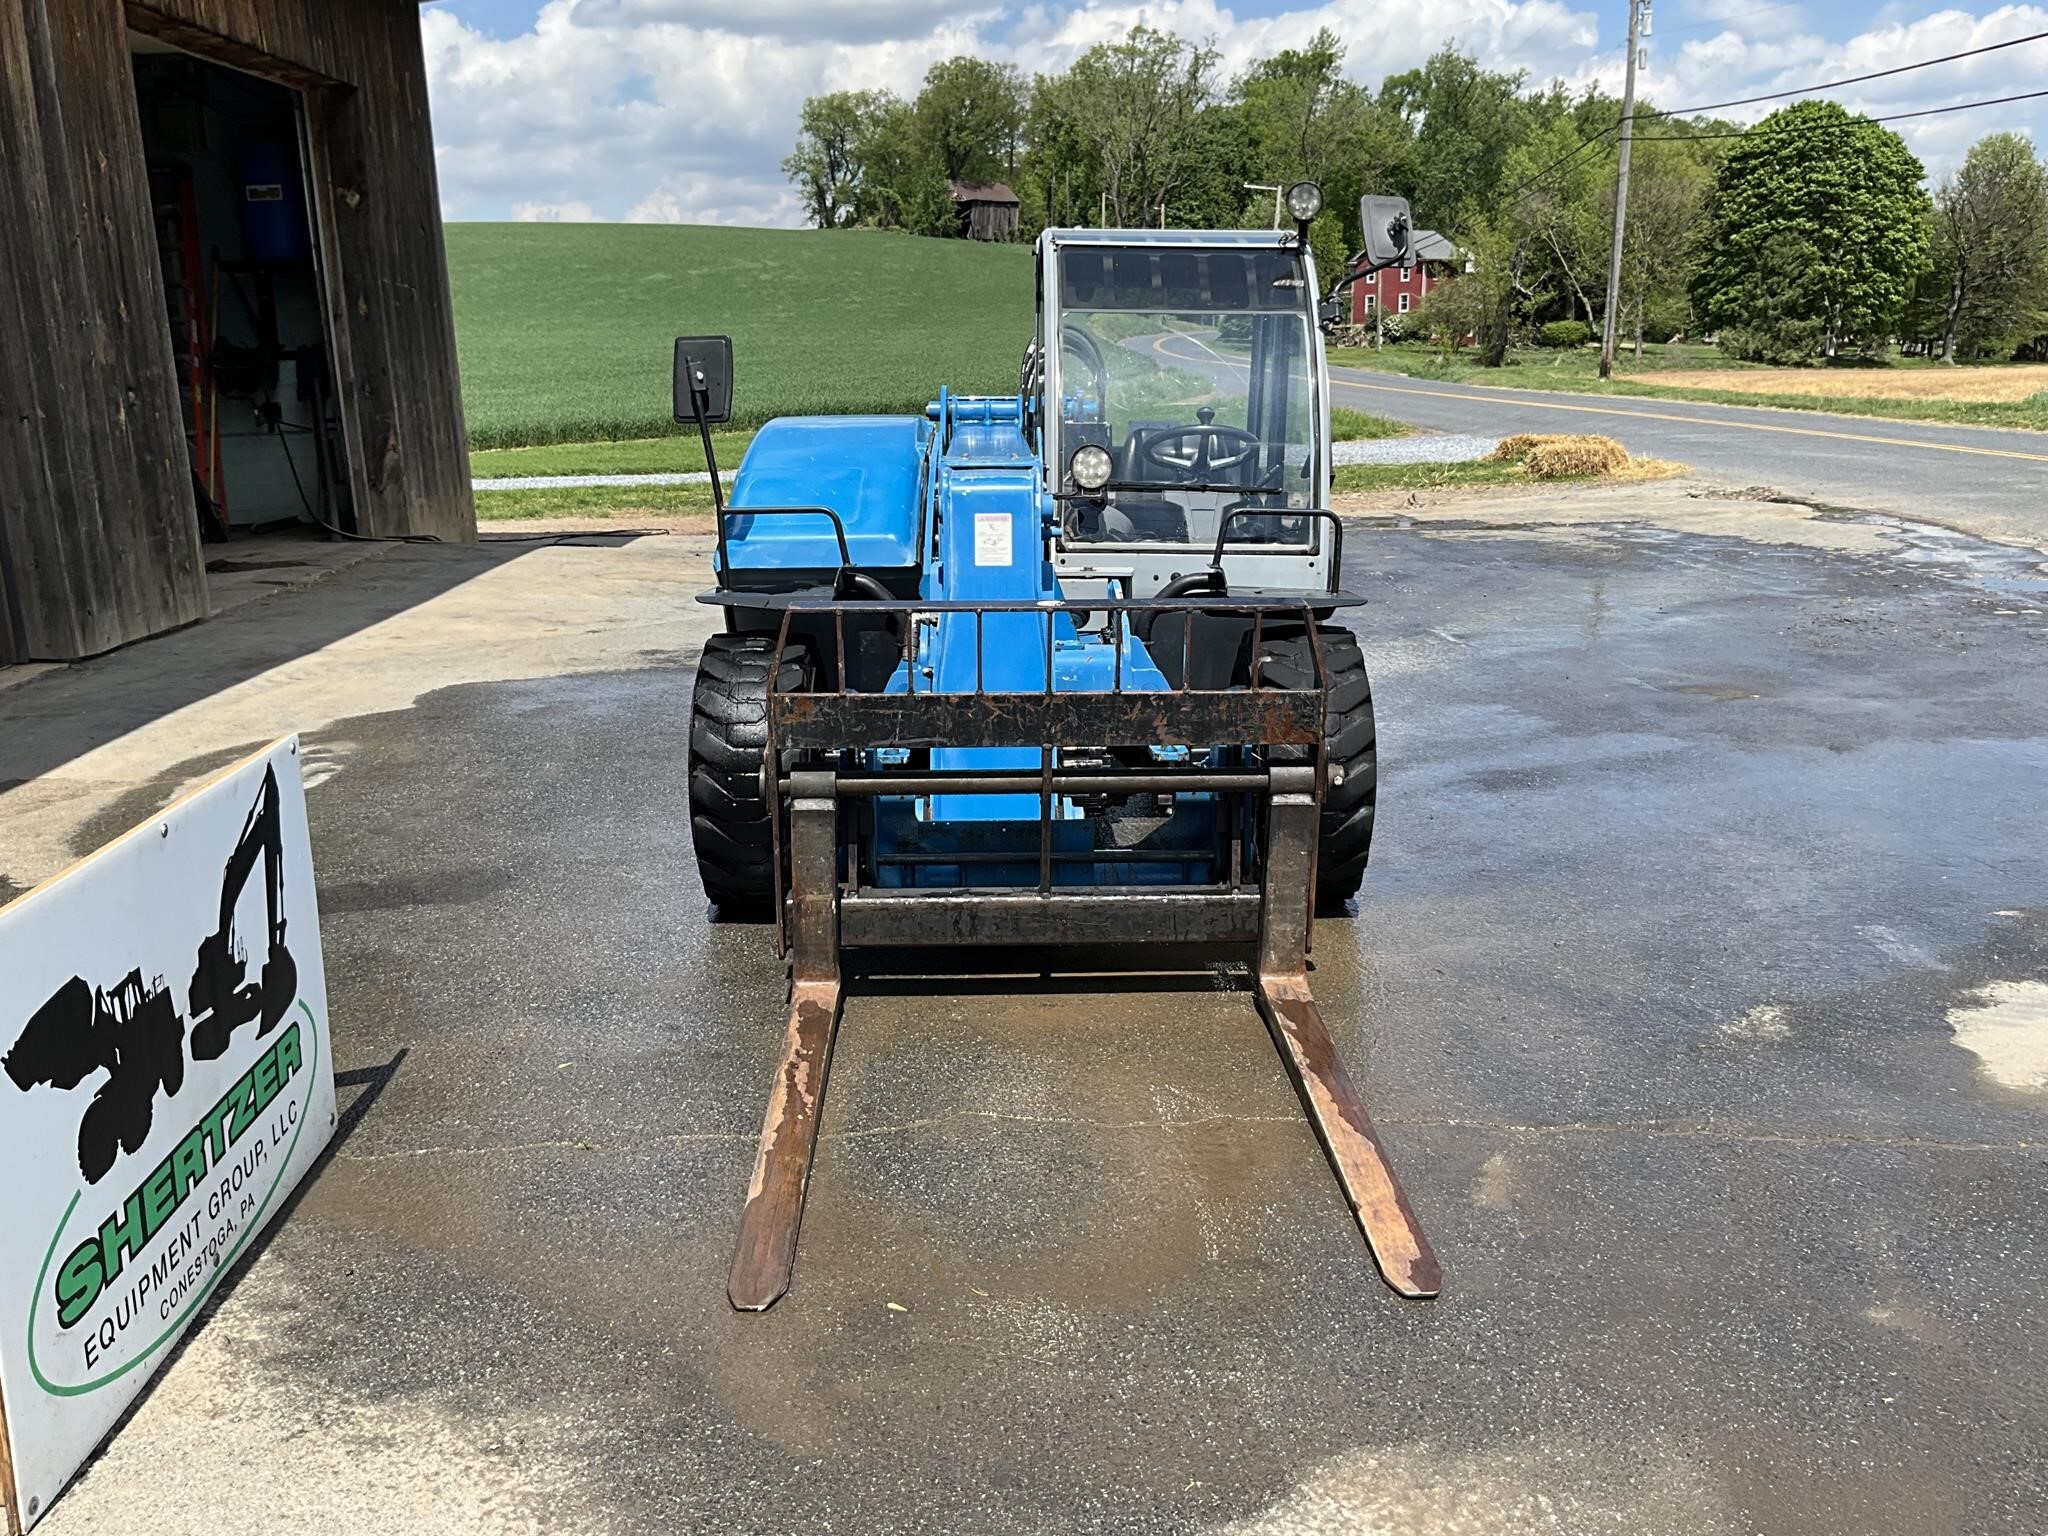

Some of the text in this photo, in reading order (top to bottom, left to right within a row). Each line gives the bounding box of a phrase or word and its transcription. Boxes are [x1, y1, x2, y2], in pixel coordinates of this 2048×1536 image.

[55, 1021, 302, 1329] SHERTZER
[84, 1100, 298, 1370] EQUIPMENT GROUP, LLC
[160, 1192, 256, 1321] CONESTOGA, PA
